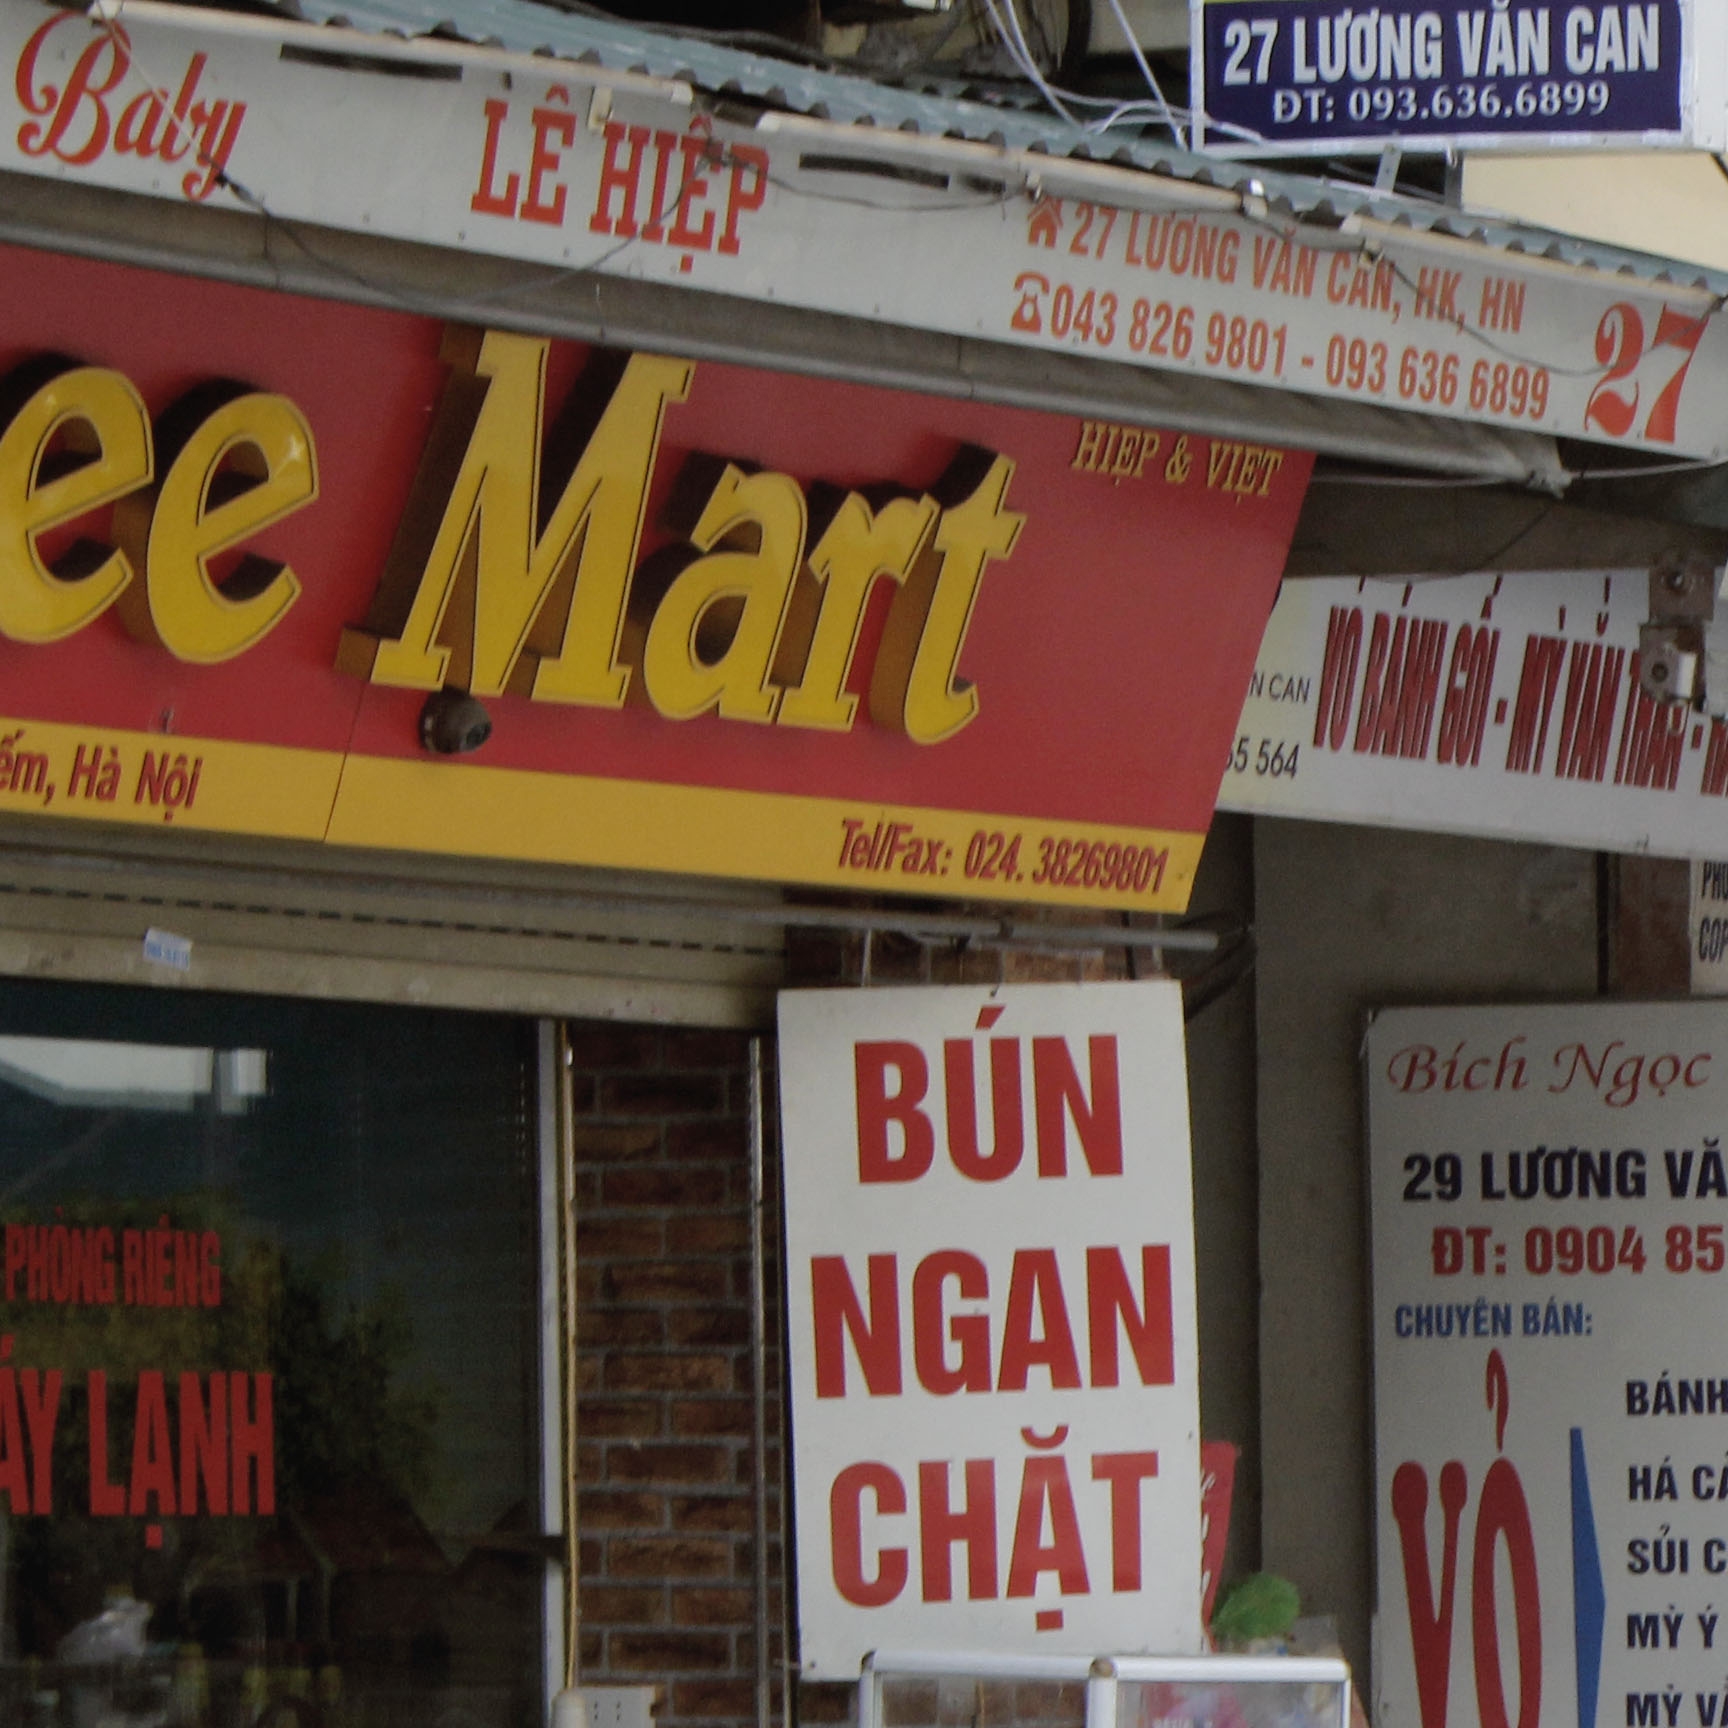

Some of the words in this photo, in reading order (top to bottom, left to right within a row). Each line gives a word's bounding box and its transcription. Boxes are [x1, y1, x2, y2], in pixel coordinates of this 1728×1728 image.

[1224, 19, 1279, 86] 27
[1294, 7, 1445, 84] LƯƠNG
[1457, 0, 1550, 78] VĂN
[1565, 3, 1661, 76] CAN
[15, 8, 247, 201] Baby
[1273, 89, 1335, 124] ĐT:
[1348, 81, 1610, 122] 093.636.6899
[471, 84, 578, 227] LÊ
[589, 116, 771, 273] HIỆP
[1068, 202, 1114, 260] 27
[1125, 208, 1240, 285] LƯƠNG
[1252, 224, 1317, 297] VĂN
[1479, 277, 1526, 333] HN
[1050, 283, 1117, 347] 043
[1129, 298, 1195, 360] 826
[1204, 312, 1288, 377] 9801
[1325, 333, 1388, 394] 093
[1399, 345, 1458, 404] 636
[1468, 358, 1550, 421] 6899
[1583, 301, 1713, 444] 27
[1165, 434, 1192, 484] &
[371, 329, 1028, 745] Mart
[1268, 673, 1312, 704] CAN
[1352, 581, 1450, 761] BÁNH
[68, 742, 122, 801] Hà
[135, 749, 203, 822] Nội
[1254, 739, 1302, 780] 564
[836, 818, 952, 877] Tel/Fax:
[1030, 844, 1170, 896] 38269801
[853, 1004, 1124, 1184] BÚN
[1386, 1036, 1530, 1095] Bích
[1547, 1041, 1713, 1109] Ngọc
[1402, 1151, 1464, 1202] 29
[1479, 1143, 1649, 1200] LƯƠNG
[1431, 1224, 1507, 1278] ĐT:
[1523, 1224, 1647, 1276] 0904
[809, 1243, 1176, 1400] NGAN
[1394, 1297, 1513, 1339] CHUYÊN
[1522, 1298, 1594, 1339] BÁN:
[87, 1368, 276, 1551] LẠNH
[1627, 1454, 1679, 1502] HÁ
[827, 1424, 1161, 1633] CHẶT
[1626, 1524, 1690, 1575] SỦI
[1697, 1602, 1720, 1650] Ý
